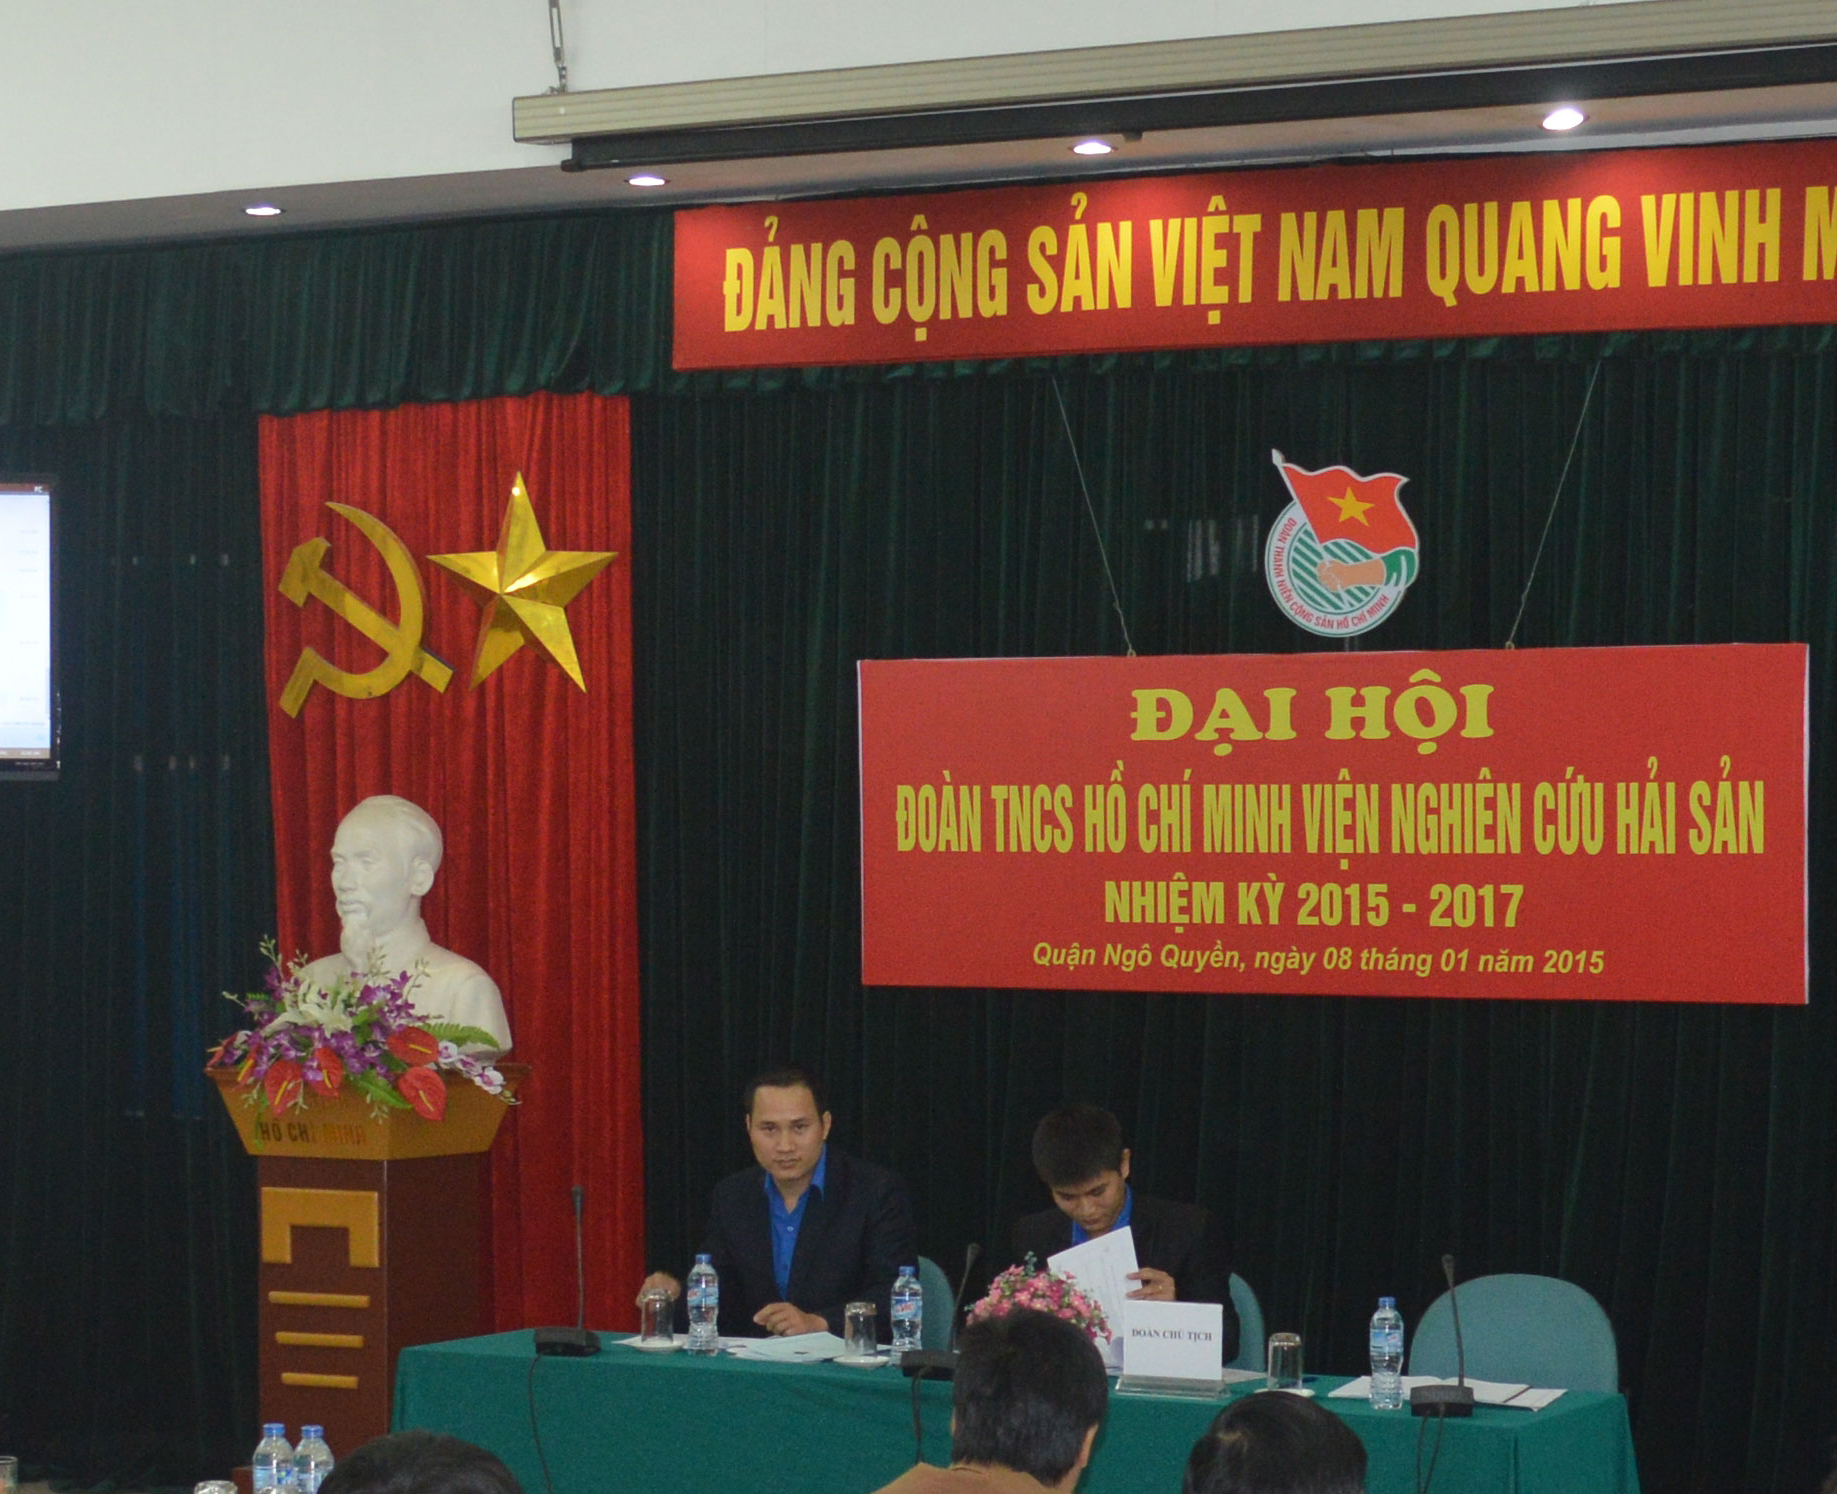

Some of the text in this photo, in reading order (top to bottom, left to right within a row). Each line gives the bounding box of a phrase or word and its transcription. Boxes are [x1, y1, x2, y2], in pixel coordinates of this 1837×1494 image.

[724, 216, 855, 331] ĐẢNG
[873, 215, 1007, 341] CỘNG
[1027, 192, 1132, 314] SẢN
[1150, 195, 1261, 324] VIỆT
[1279, 208, 1404, 301] NAM
[1427, 196, 1621, 306] QUANG
[1641, 188, 1781, 287] VINH
[1368, 594, 1390, 619] MINH
[1131, 668, 1494, 756] ĐẠI HỘI
[896, 756, 1764, 869] ĐOÀN TNCS HỒ CHÍ MINH VIỆN NGHIÊN CỨU HẢI SẢN
[1106, 872, 1523, 933] NHIỆM KỲ 2015 - 2017
[1034, 940, 1605, 977] Quận Ngô Quyền, ngày 08 tháng 01 năm 2015
[1187, 1331, 1213, 1343] TỊCH
